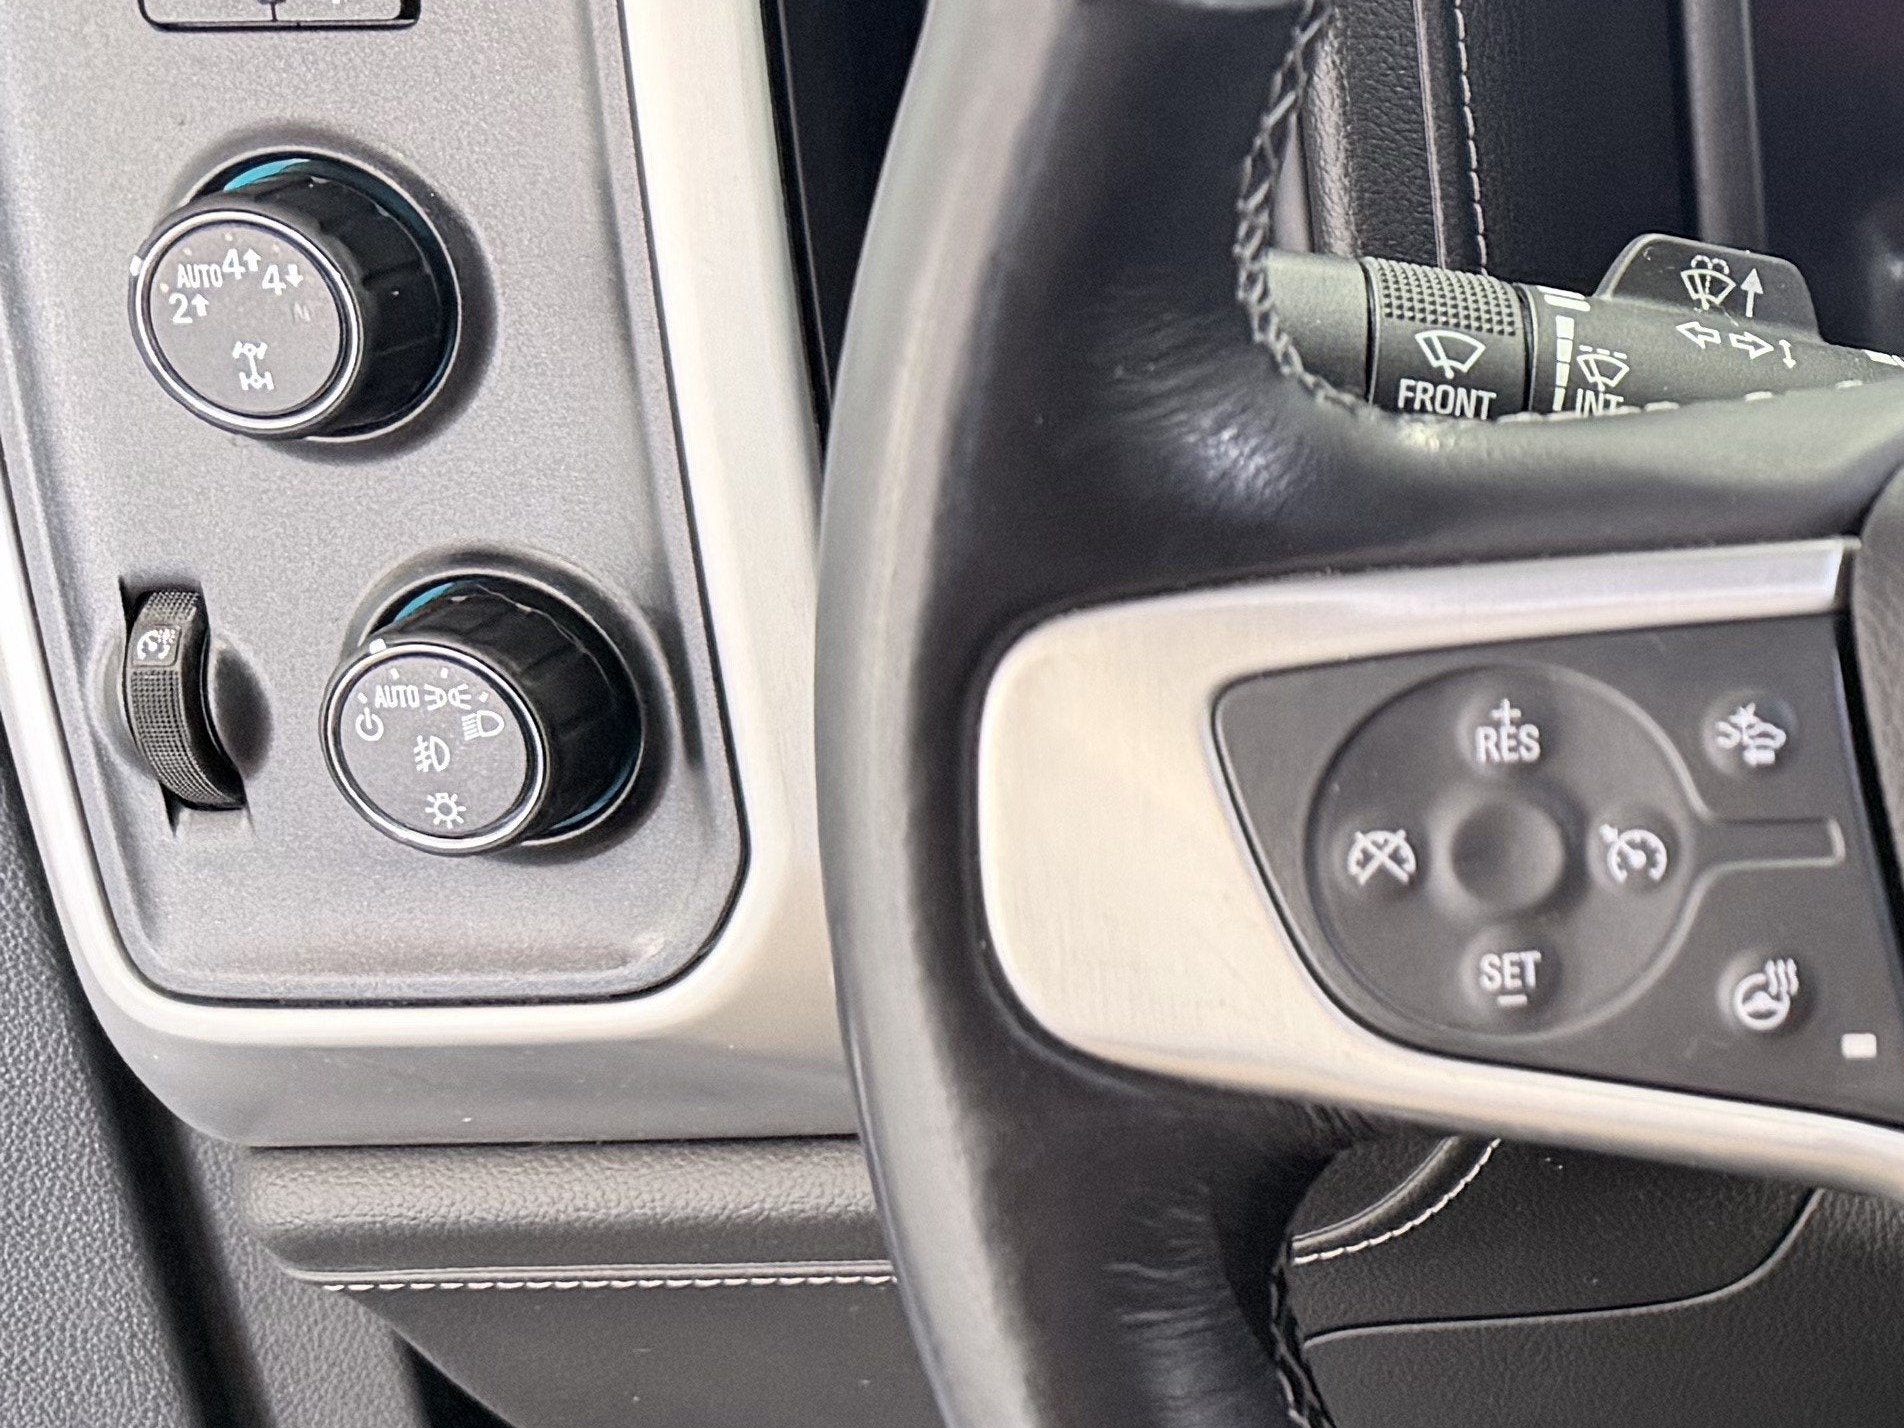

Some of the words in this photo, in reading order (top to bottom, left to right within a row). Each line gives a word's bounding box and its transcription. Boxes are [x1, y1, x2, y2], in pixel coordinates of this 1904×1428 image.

[176, 263, 224, 289] AUTO
[221, 246, 246, 282] 4
[260, 262, 288, 298] 4
[167, 291, 194, 325] 2
[1398, 378, 1498, 420] FRONT
[1575, 388, 1624, 418] INT
[374, 684, 421, 710] AUTO
[1474, 722, 1542, 764] RES
[1478, 950, 1542, 993] SET
